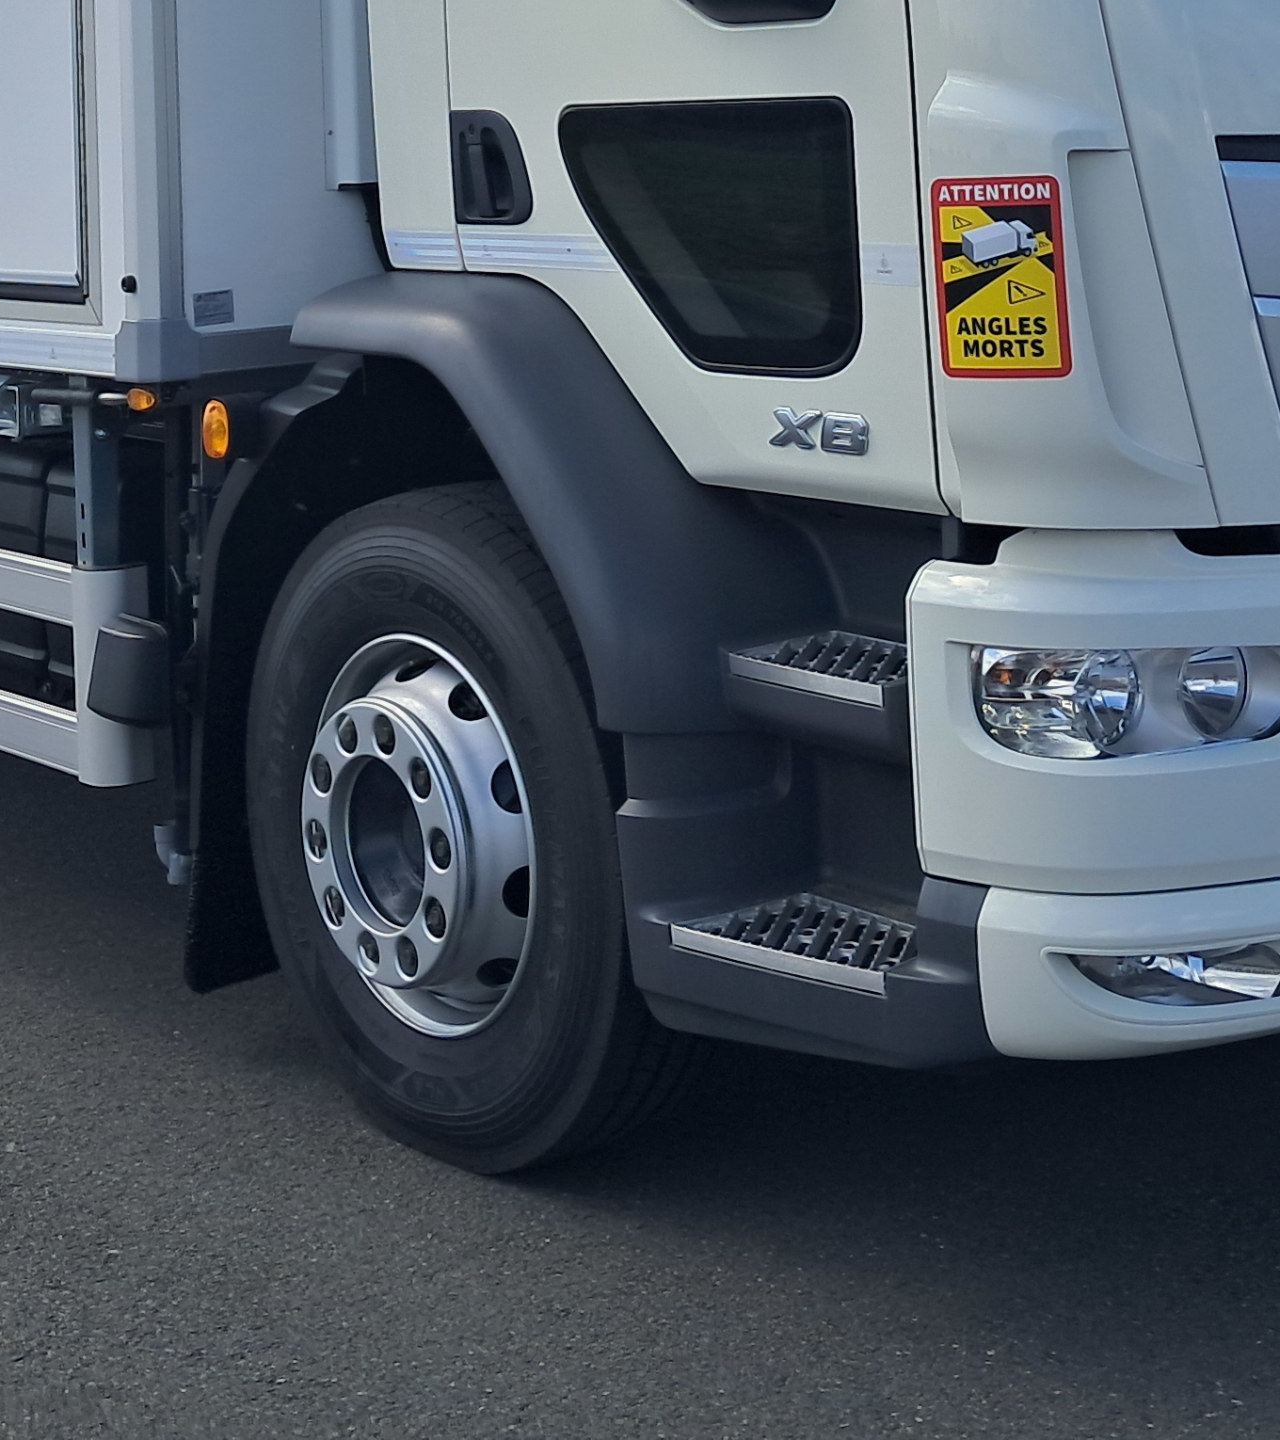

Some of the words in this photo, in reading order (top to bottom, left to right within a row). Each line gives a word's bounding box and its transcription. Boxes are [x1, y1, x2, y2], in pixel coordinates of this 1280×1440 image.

[938, 182, 1051, 202] ATTENTION
[957, 316, 1047, 336] ANGLES
[963, 339, 1045, 358] MORTS
[769, 405, 870, 456] XB
